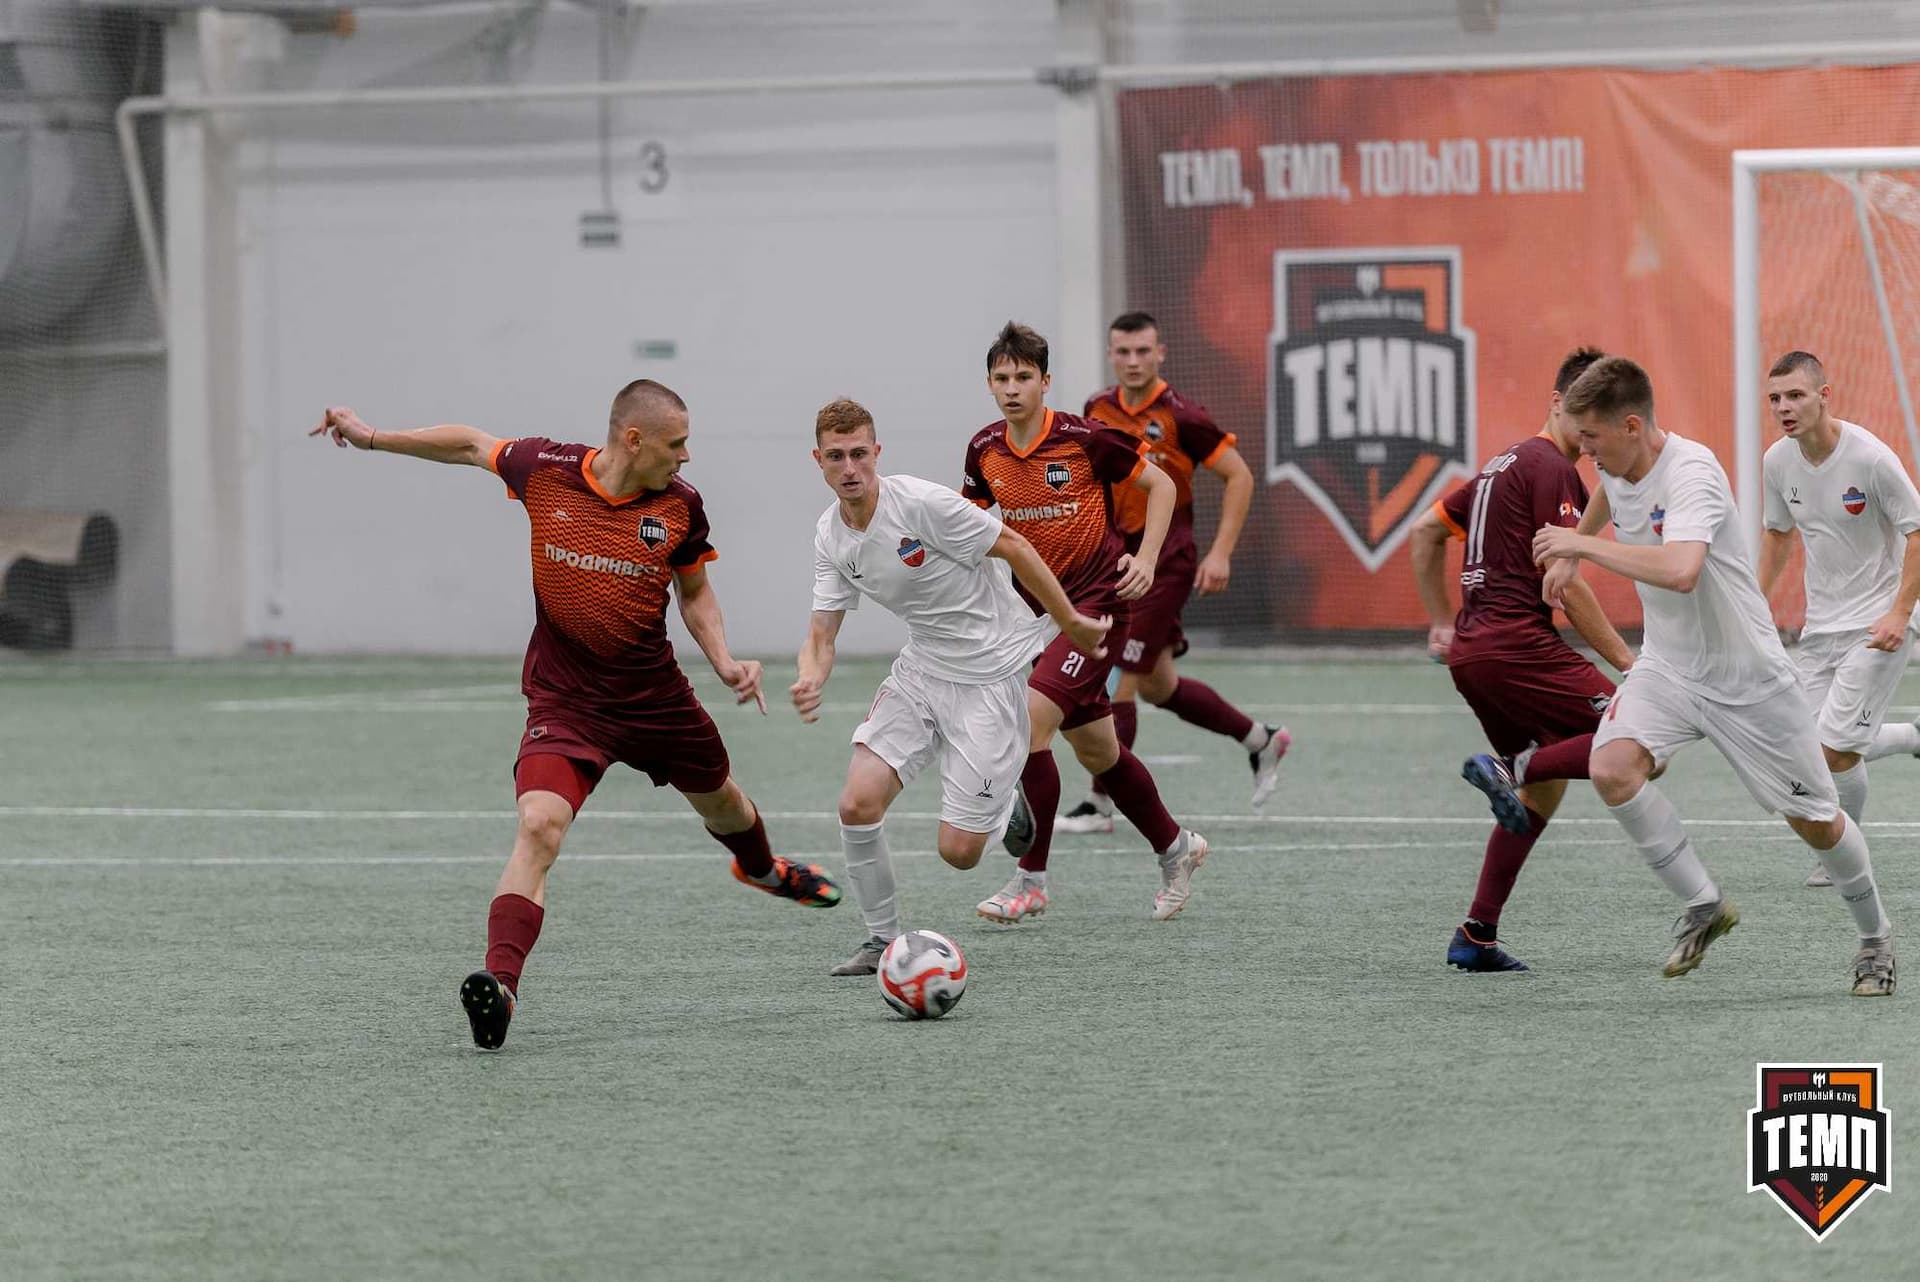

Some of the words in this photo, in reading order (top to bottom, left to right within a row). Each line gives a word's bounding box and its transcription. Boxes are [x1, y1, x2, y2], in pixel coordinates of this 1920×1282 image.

[639, 140, 669, 195] 3
[1159, 148, 1254, 208] ТЕМП,
[1258, 142, 1351, 204] ТЕМП,
[1357, 139, 1480, 197] ТОЛЬКО
[1487, 136, 1584, 193] ТЕМП!
[1283, 336, 1457, 448] ТЕМП
[1047, 470, 1070, 483] ТЕМП
[1001, 502, 1080, 521] РОДИНВЕСТ
[1466, 477, 1495, 566] 11
[642, 525, 665, 541] ТЕМП
[1060, 650, 1085, 678] 21
